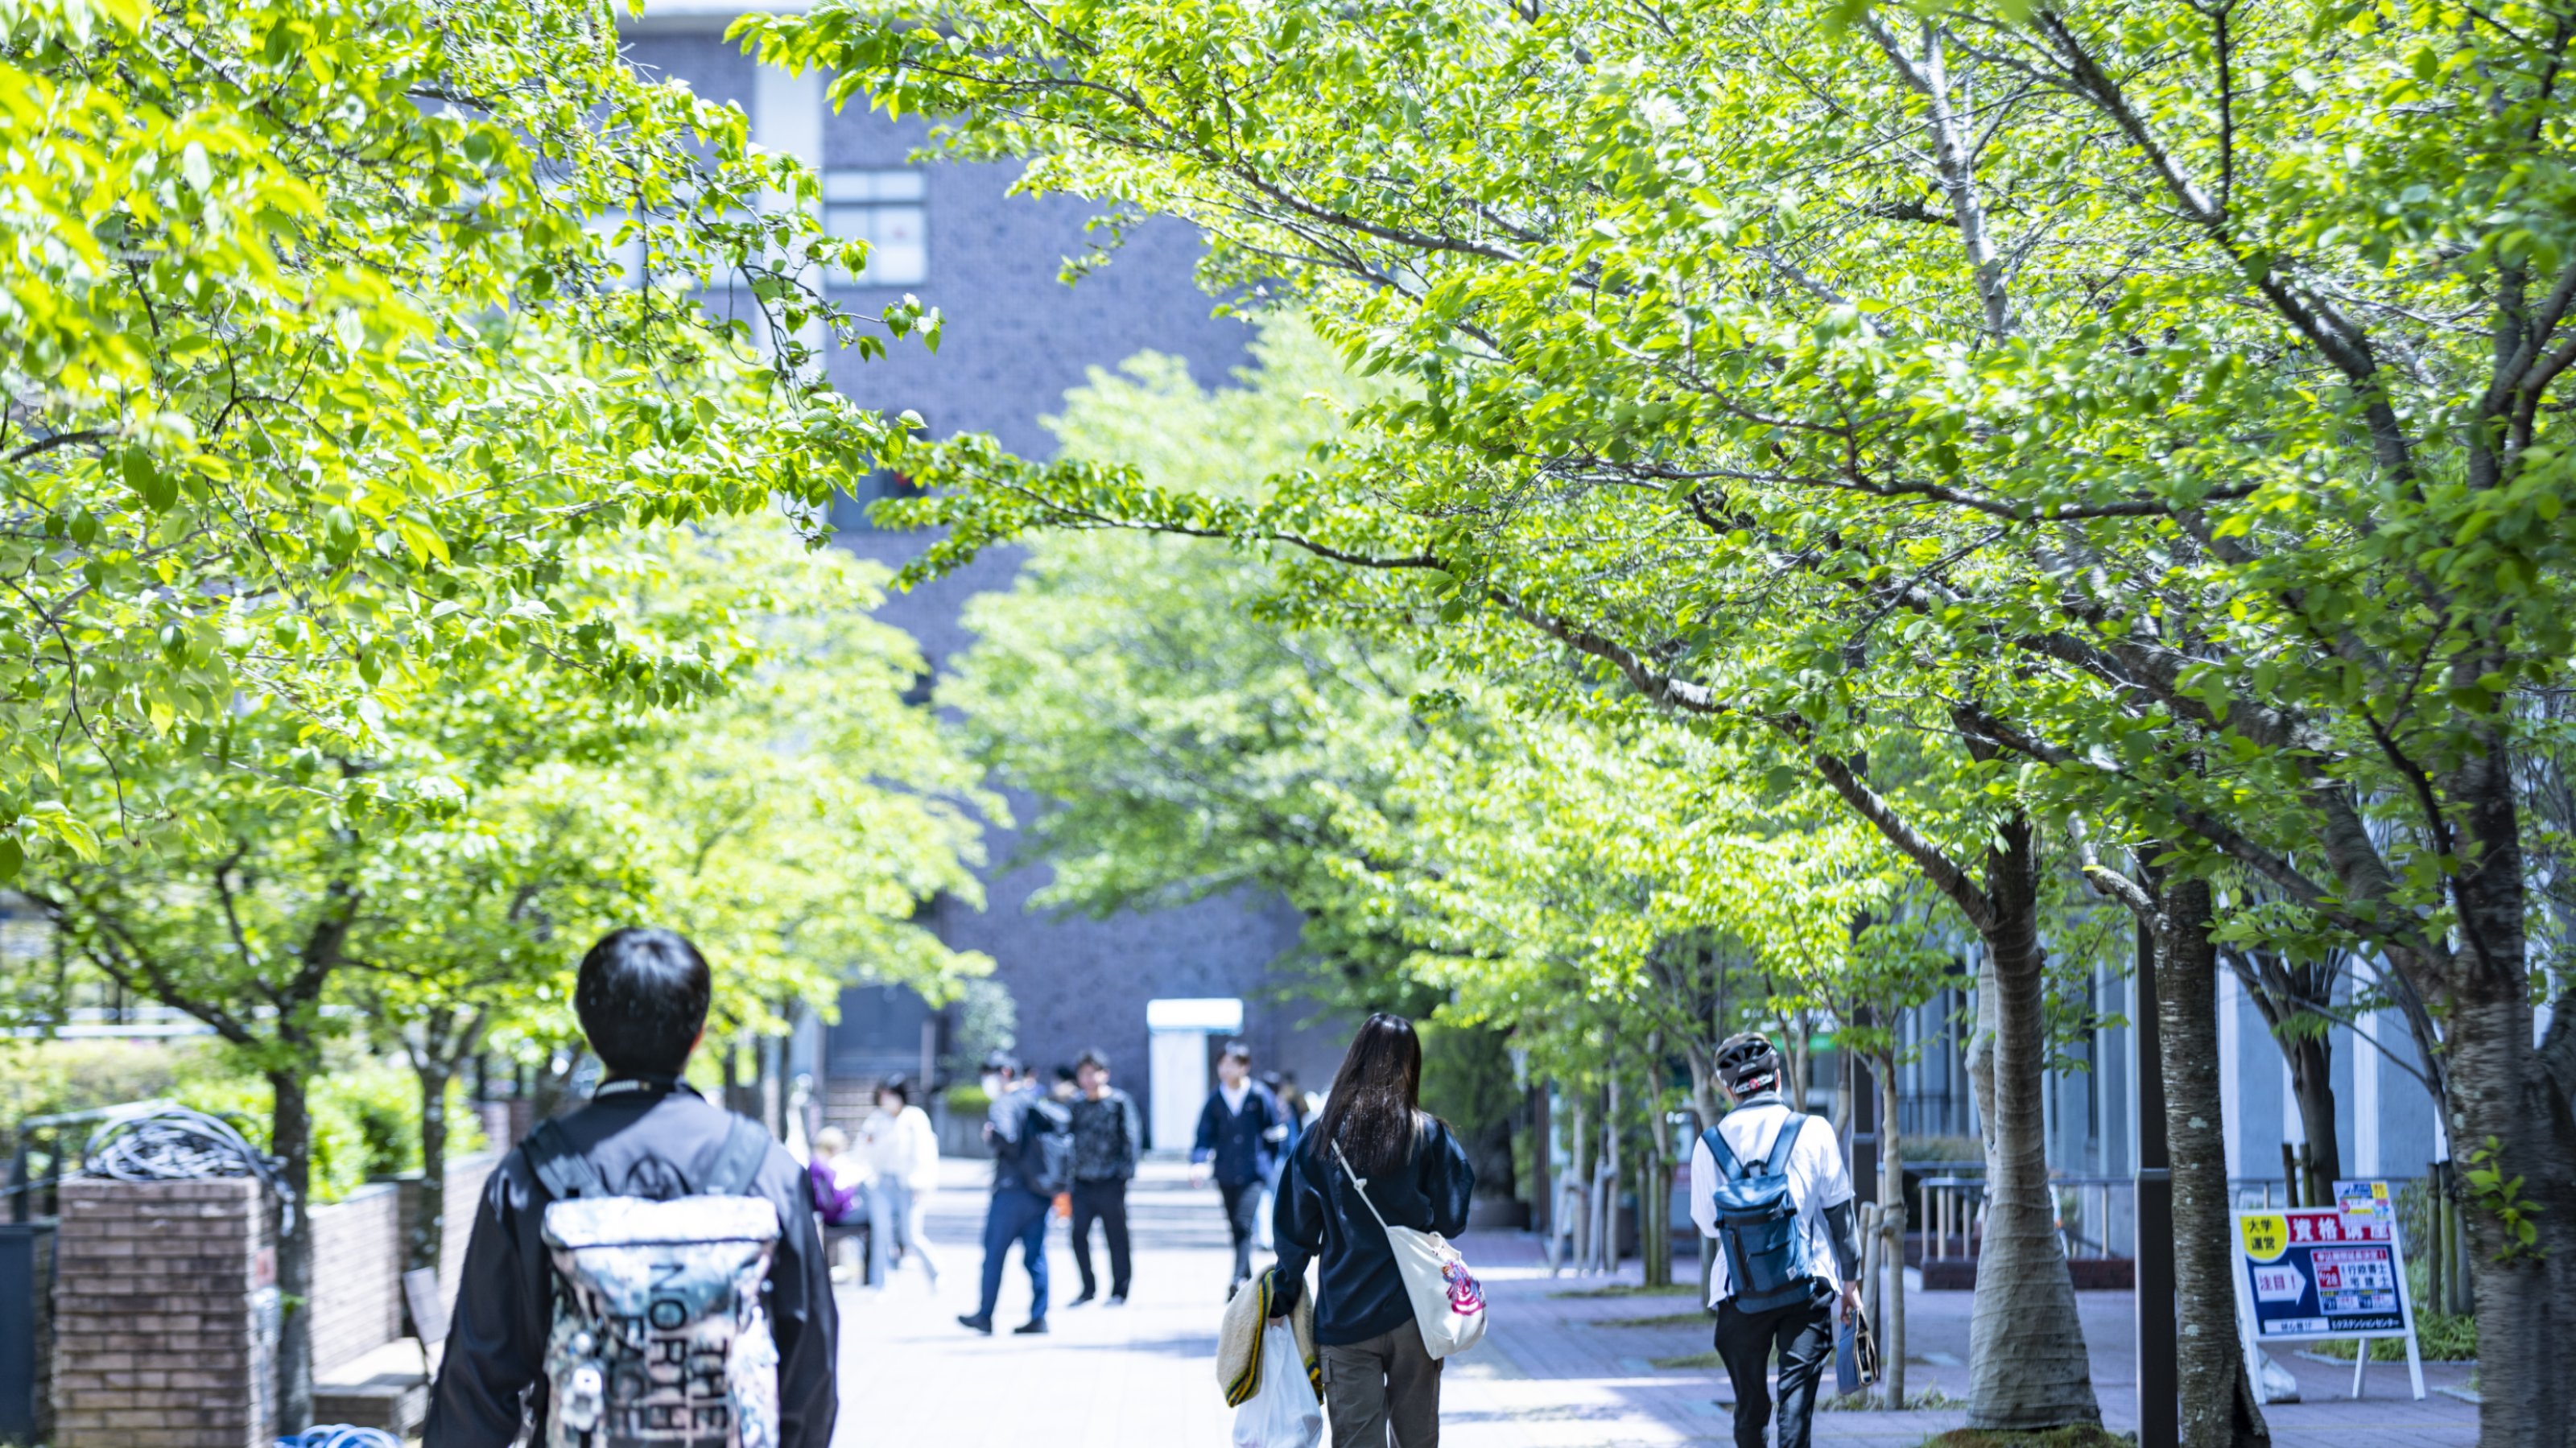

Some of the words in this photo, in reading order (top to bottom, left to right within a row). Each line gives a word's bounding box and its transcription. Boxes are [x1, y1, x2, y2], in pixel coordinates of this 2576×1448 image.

[2248, 1218, 2273, 1233] 大学
[2251, 1236, 2275, 1251] 運営
[2347, 1264, 2388, 1275] 行政書士
[649, 1264, 687, 1429] NORTH
[691, 1337, 728, 1429] THE
